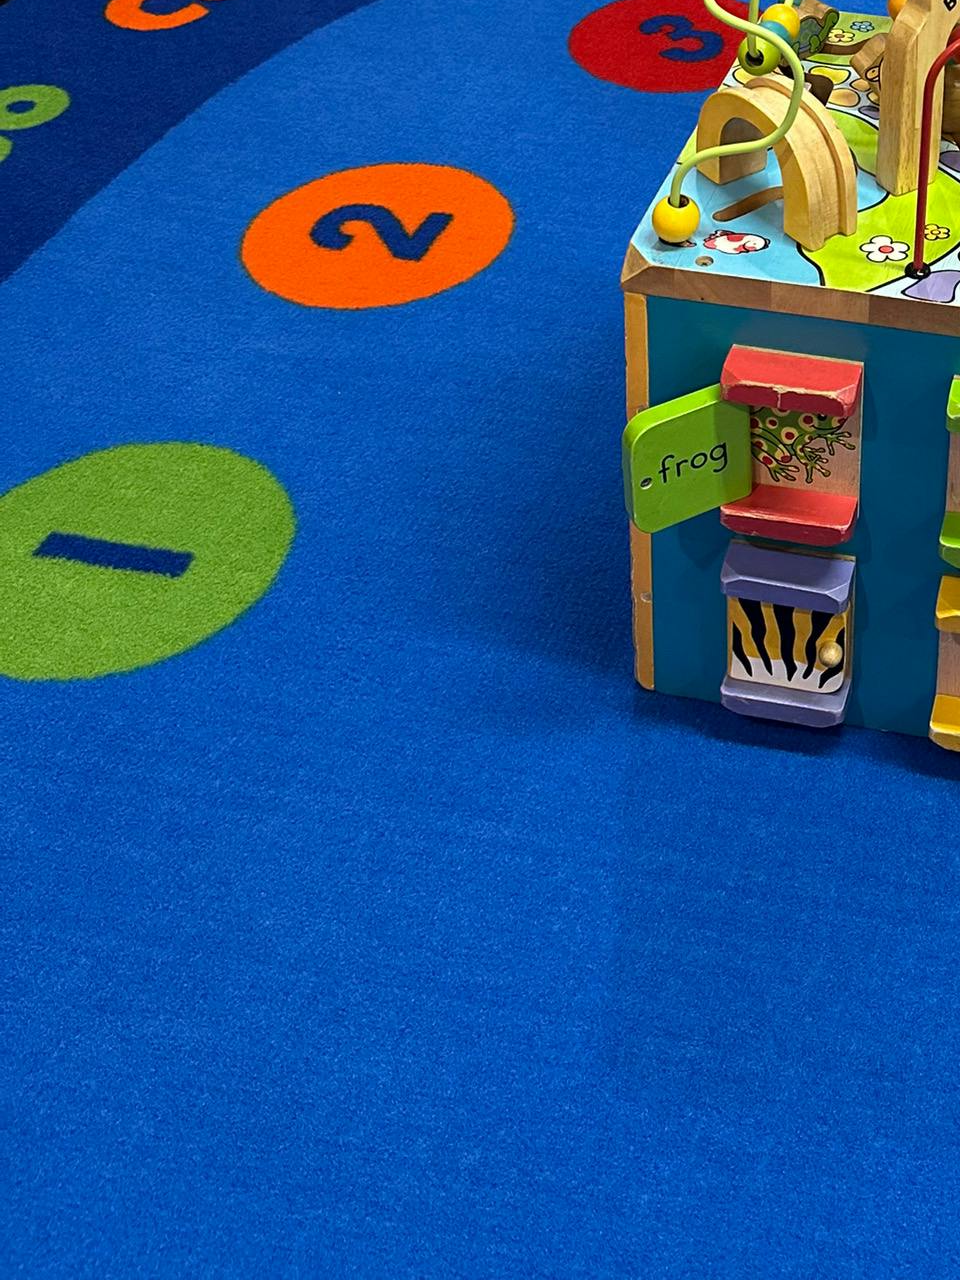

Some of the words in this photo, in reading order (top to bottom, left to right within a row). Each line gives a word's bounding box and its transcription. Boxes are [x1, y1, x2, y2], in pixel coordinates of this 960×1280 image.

[640, 15, 723, 62] 3
[310, 204, 453, 262] 2
[658, 440, 730, 486] frog
